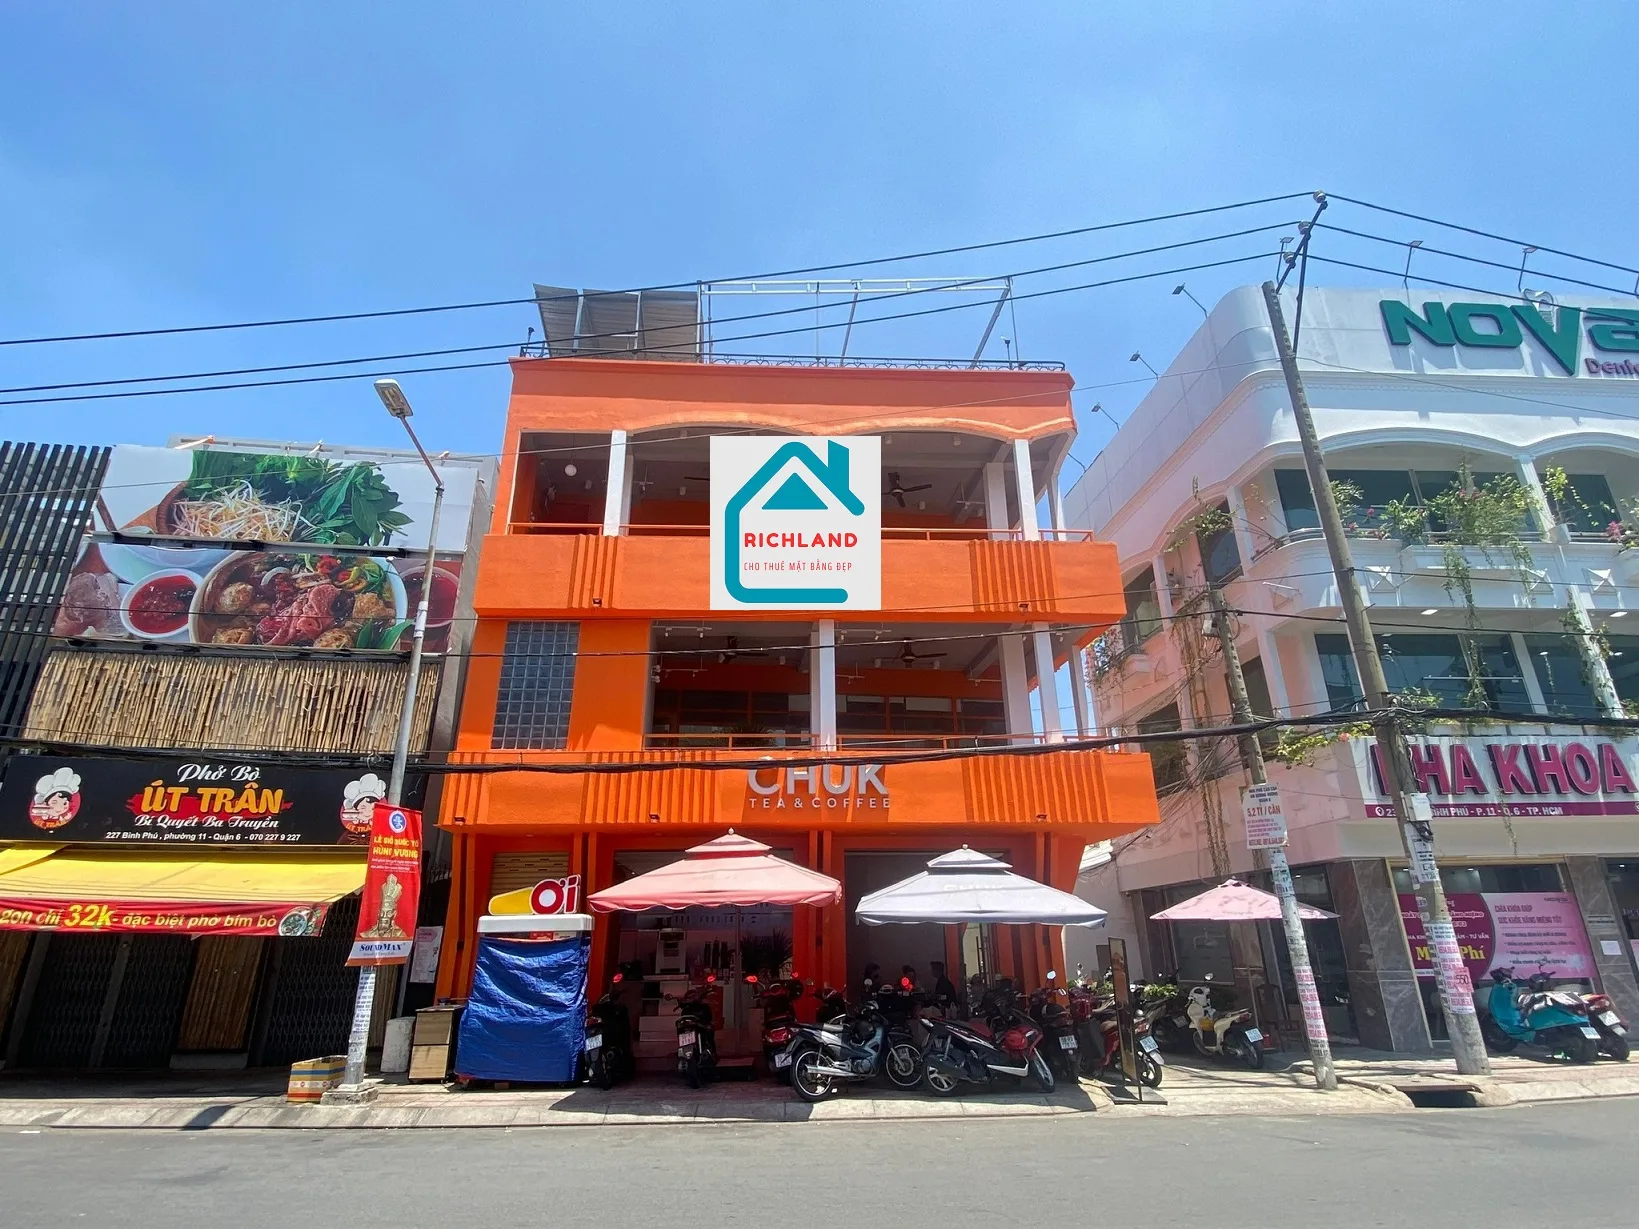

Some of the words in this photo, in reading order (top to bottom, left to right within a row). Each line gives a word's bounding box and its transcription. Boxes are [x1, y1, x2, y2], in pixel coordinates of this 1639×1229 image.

[177, 763, 226, 783] Phở
[230, 764, 261, 781] Bò
[748, 756, 889, 795] CHUK
[1370, 743, 1489, 796] HA
[1487, 742, 1639, 796] KHOA
[140, 779, 190, 813] ÚT
[196, 782, 284, 814] TRÂN
[135, 814, 152, 828] Bí
[157, 814, 199, 829] Quyết
[228, 815, 280, 830] Truyền
[122, 831, 141, 839] Bình
[164, 832, 196, 842] phường
[198, 832, 207, 840] 11
[213, 832, 234, 841] Quận
[249, 833, 264, 841] 070
[264, 833, 279, 841] 227
[280, 833, 285, 841] 9
[286, 833, 301, 841] 227
[155, 913, 186, 928] biệt
[1460, 944, 1486, 960] Phí
